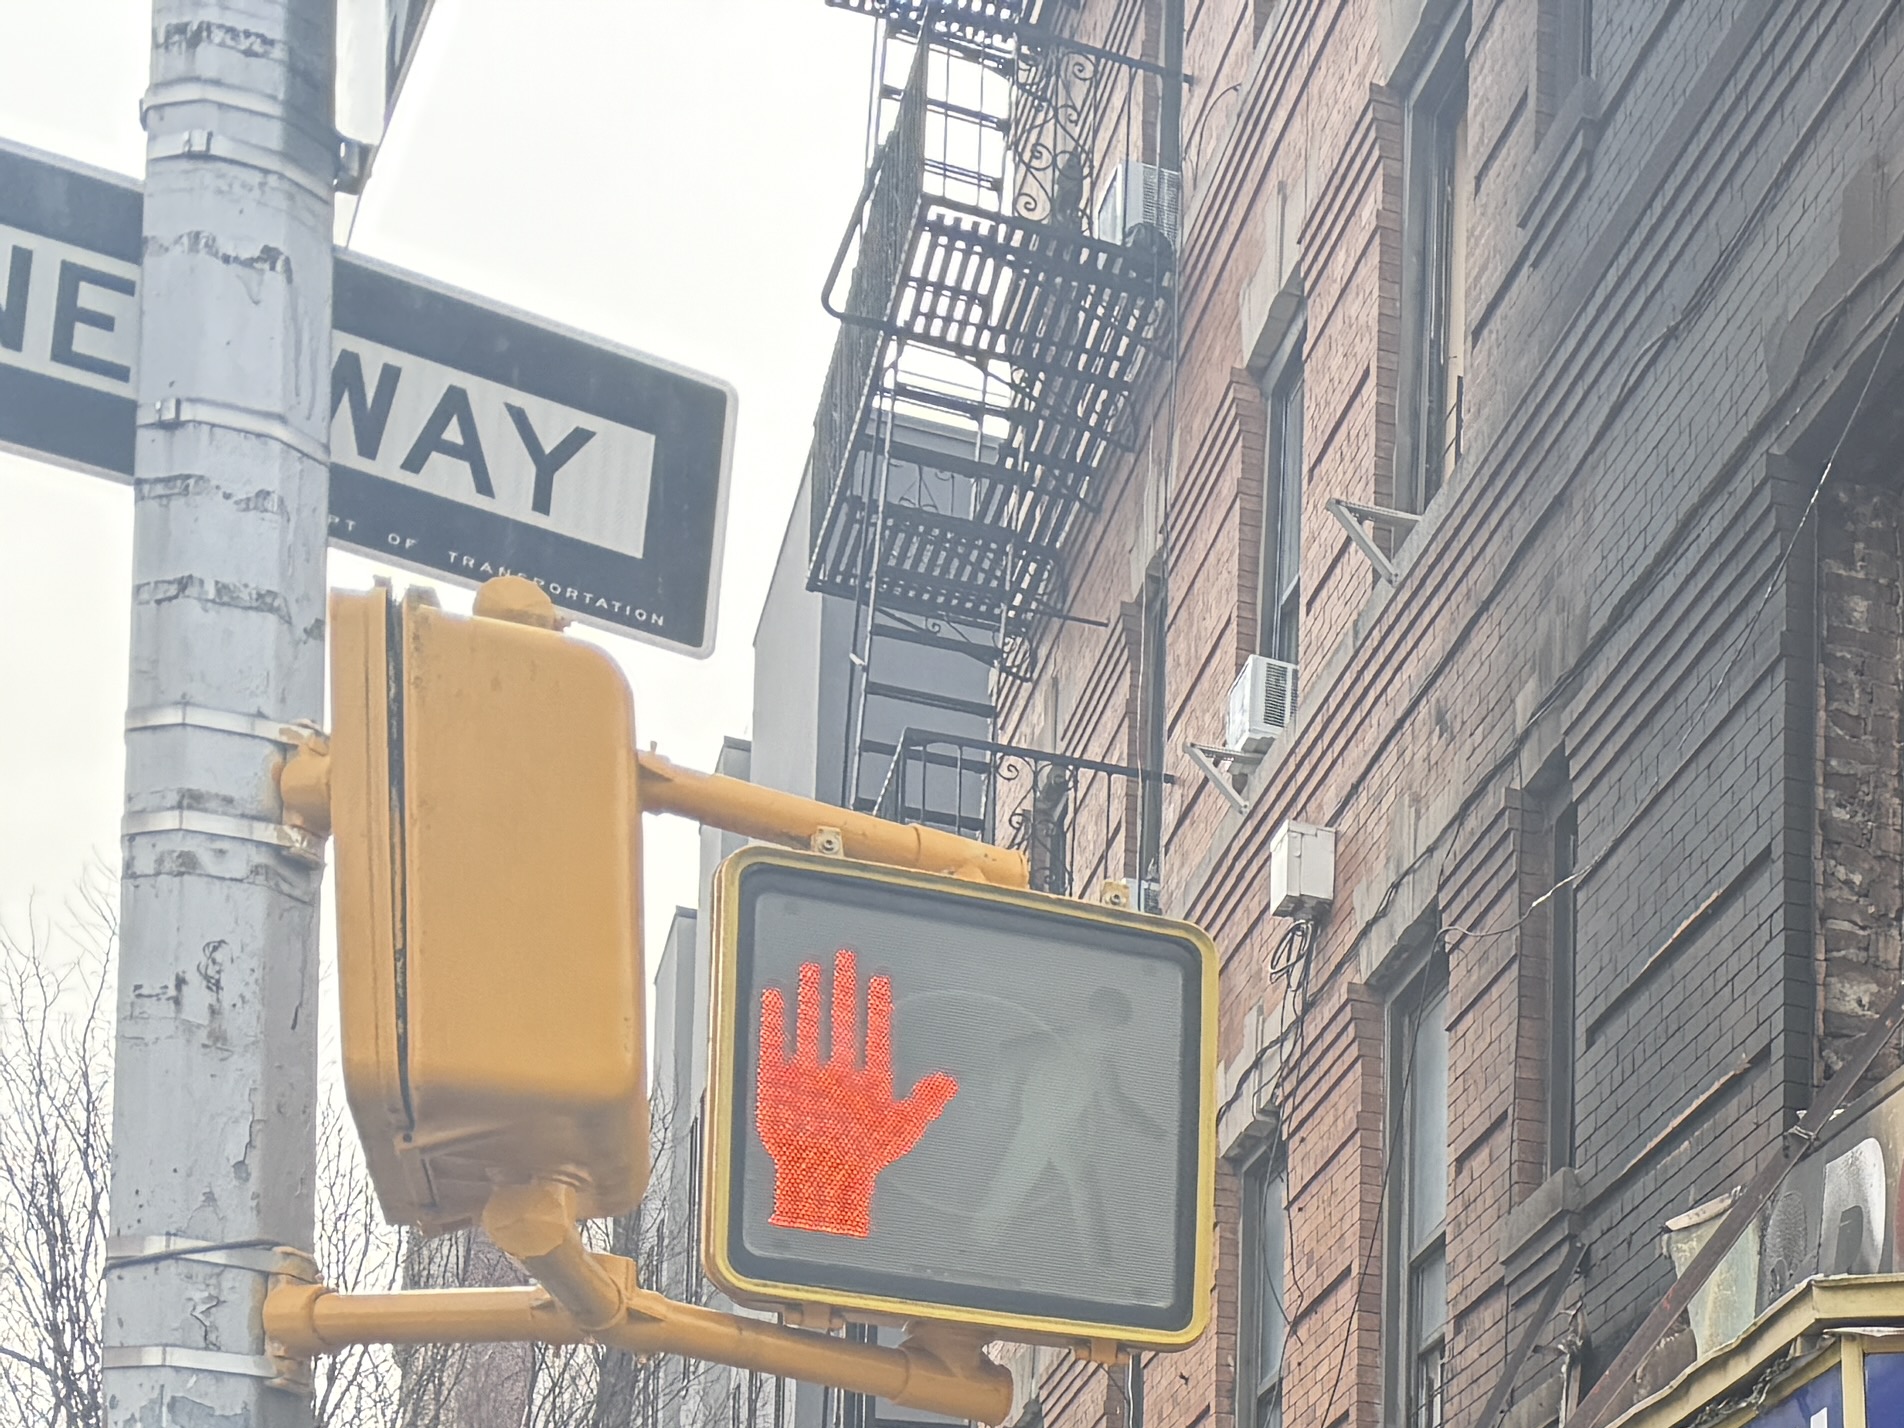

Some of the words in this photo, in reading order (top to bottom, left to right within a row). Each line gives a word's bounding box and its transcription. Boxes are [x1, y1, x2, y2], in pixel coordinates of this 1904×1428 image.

[332, 350, 598, 518] WAY
[388, 533, 418, 548] OF
[448, 551, 665, 626] TRANPORTATION
